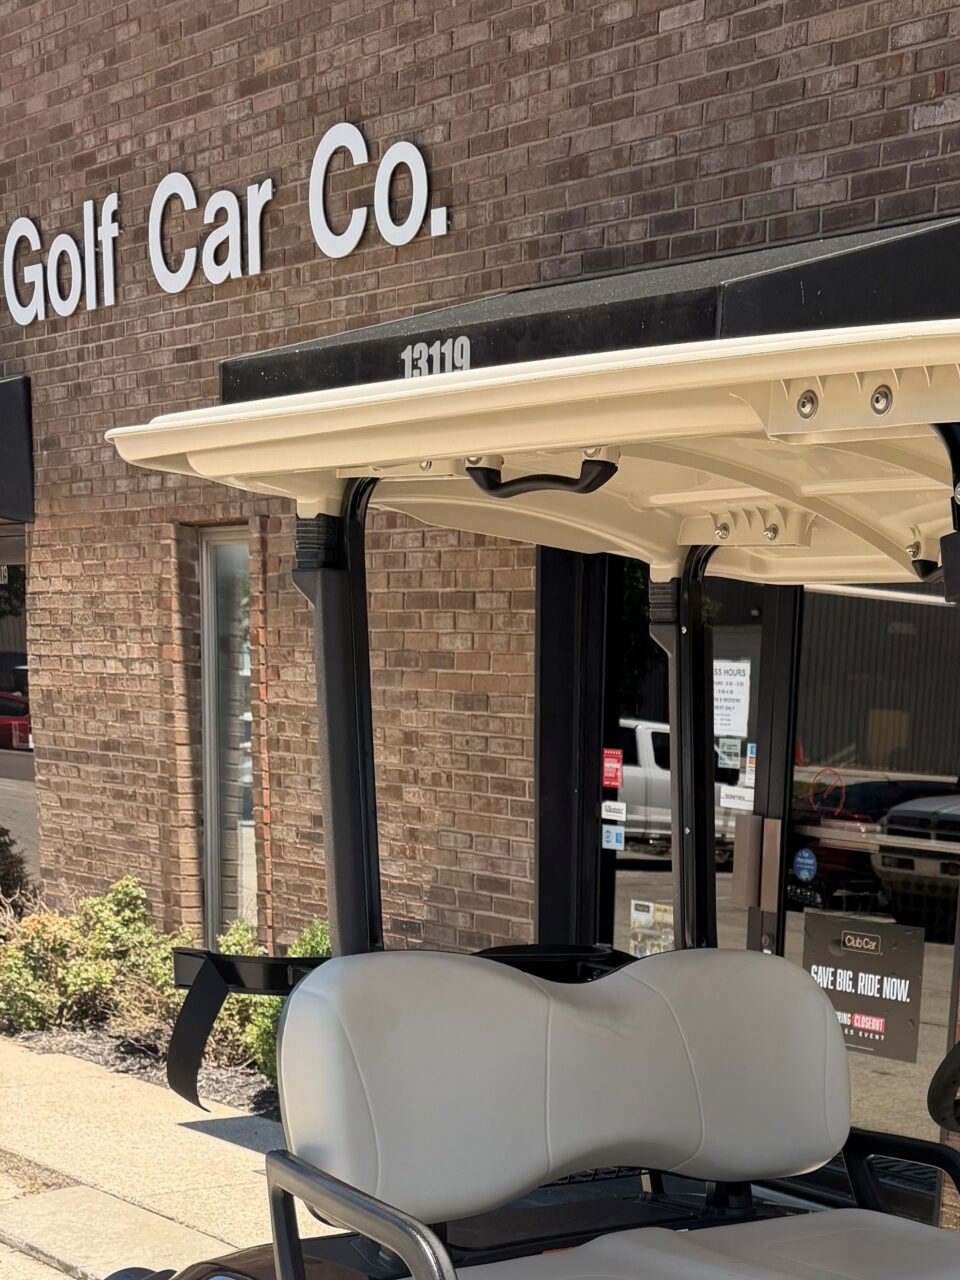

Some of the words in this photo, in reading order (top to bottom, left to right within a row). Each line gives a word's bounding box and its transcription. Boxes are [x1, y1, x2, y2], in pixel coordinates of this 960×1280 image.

[3, 192, 120, 326] Golf
[148, 171, 274, 294] Car
[308, 122, 448, 259] Co.
[400, 335, 471, 379] 13119
[723, 668, 746, 677] HOURS
[845, 934, 863, 948] Club
[863, 937, 877, 950] Car
[810, 964, 835, 990] SAVE
[836, 969, 856, 994] BIG.
[857, 972, 881, 998] RIDE
[882, 976, 911, 1003] NOW.
[836, 1010, 851, 1026] RING
[853, 1013, 885, 1032] CLOSEOUT
[844, 1028, 854, 1036] ES
[858, 1031, 885, 1041] EVENT
